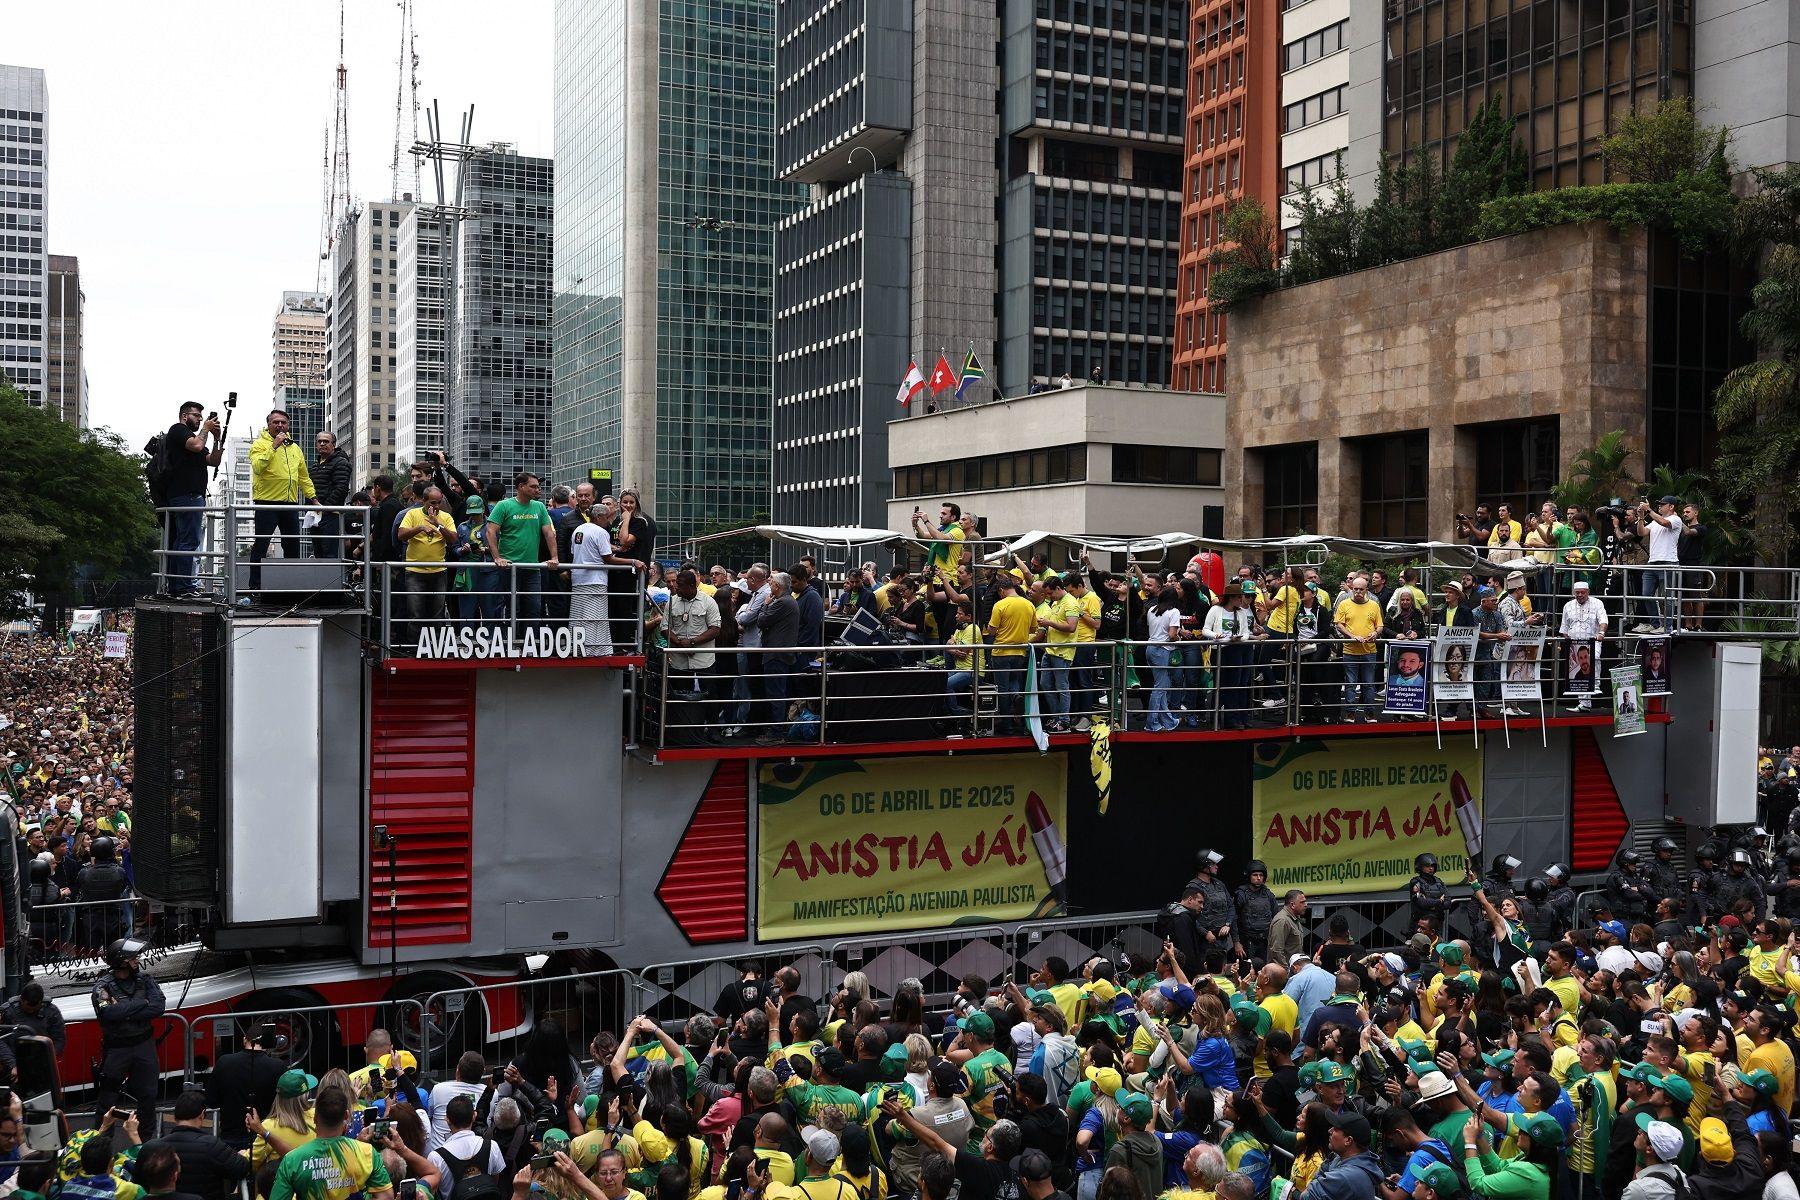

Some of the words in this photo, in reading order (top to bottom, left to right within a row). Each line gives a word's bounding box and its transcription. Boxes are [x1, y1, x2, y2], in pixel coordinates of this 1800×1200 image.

[416, 626, 586, 659] AVASSALADOR
[1444, 628, 1474, 637] ANISTIA
[1513, 630, 1542, 638] ANISTIA
[1293, 771, 1313, 791] 06
[1318, 770, 1337, 789] DE
[1341, 767, 1383, 788] ABRIL
[1387, 766, 1406, 786] DE
[1410, 764, 1448, 784] 2025
[820, 793, 845, 816] 06
[851, 792, 875, 815] DE
[880, 789, 934, 813] ABRIL
[939, 788, 962, 809] DE
[967, 785, 1015, 807] 2025
[1263, 806, 1397, 848] ANISTIA
[1402, 792, 1452, 838] JÁ!
[772, 831, 952, 882] ANISTIA
[961, 814, 1027, 867] JÁ!
[1272, 859, 1361, 885] MANIFESTAÇÃO
[1364, 858, 1410, 878] AVENIDA
[793, 890, 905, 920] MANIFESTAÇÃO
[909, 889, 968, 912] AVENIDA
[973, 884, 1036, 908] PAULISTA
[1331, 1068, 1343, 1077] 22
[302, 1156, 333, 1170] PÁTRIA
[312, 1168, 340, 1180] AMADA
[326, 1177, 355, 1189] BRASIL
